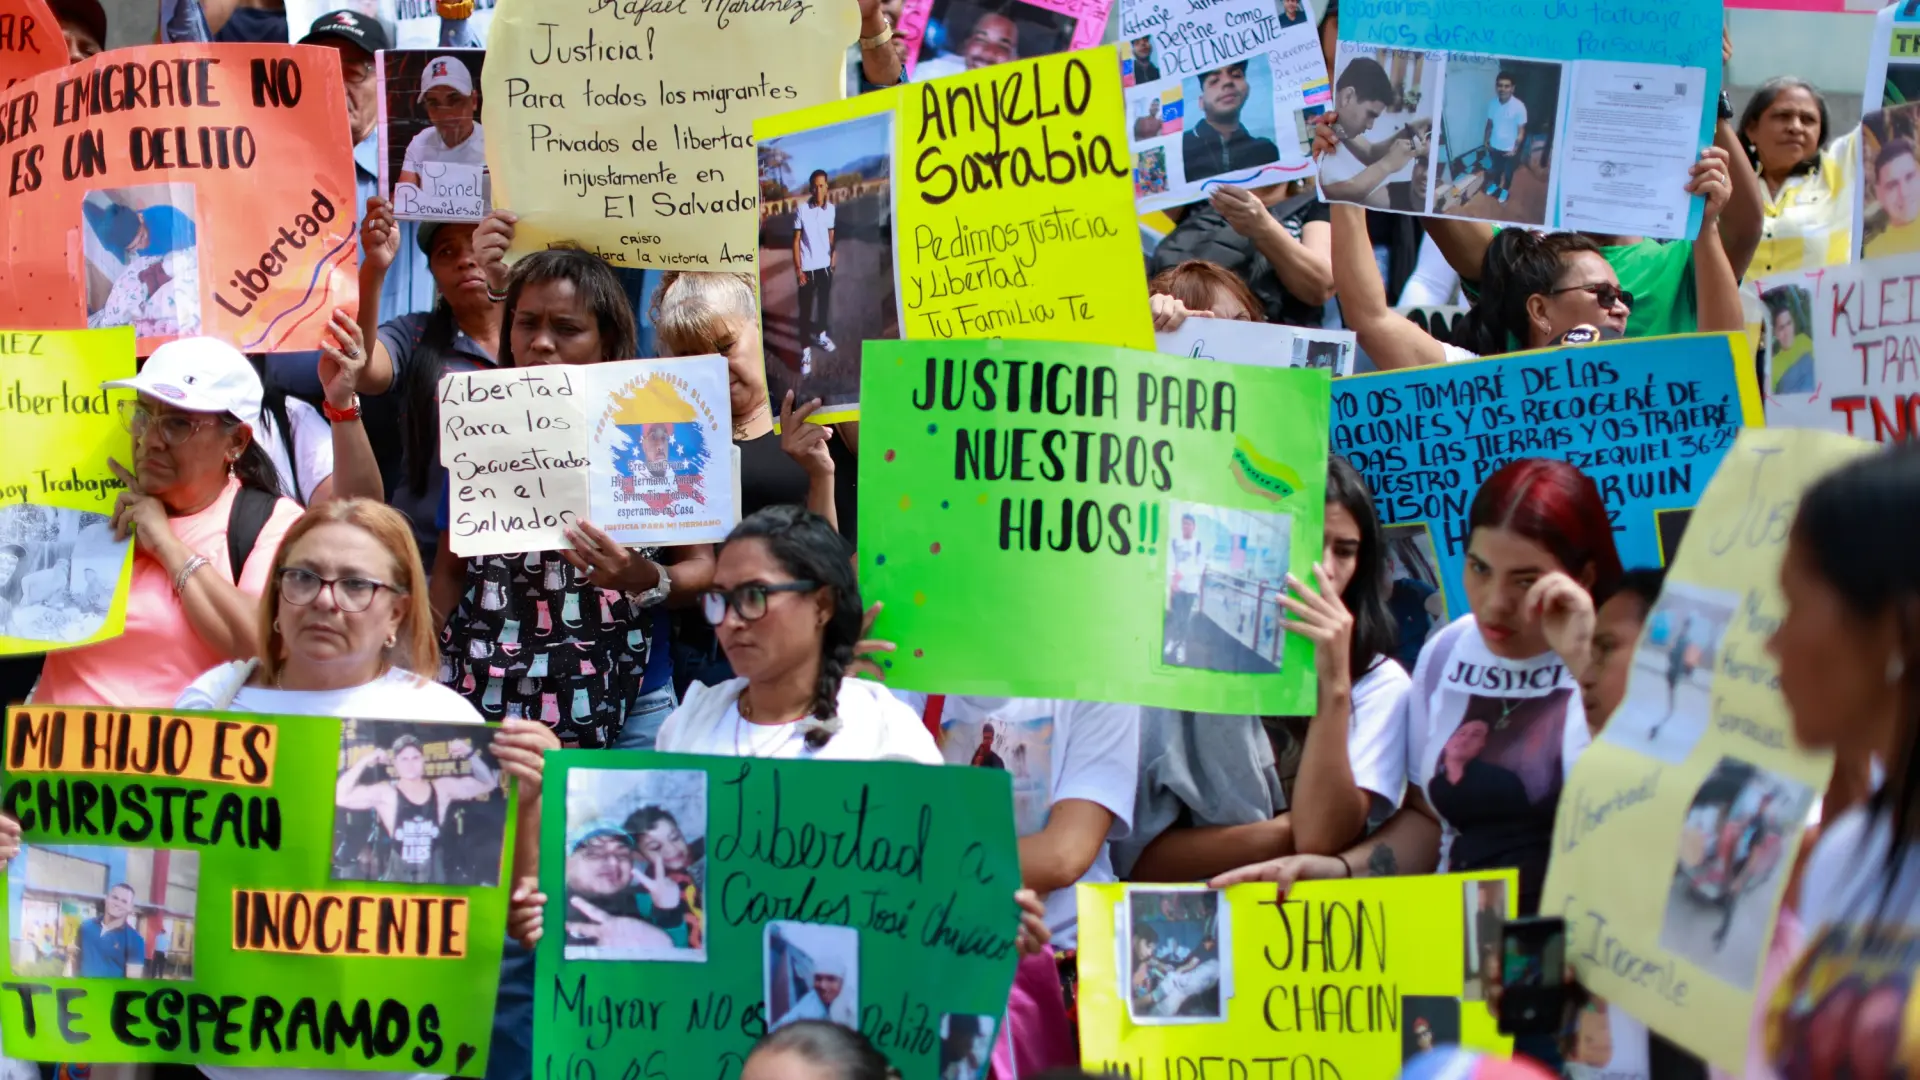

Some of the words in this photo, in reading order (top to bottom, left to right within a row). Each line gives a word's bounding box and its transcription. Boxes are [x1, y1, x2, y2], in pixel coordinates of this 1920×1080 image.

[529, 22, 655, 65] Justicia!
[54, 58, 221, 128] EMIGRATE
[250, 58, 302, 108] NO
[505, 77, 565, 109] Para
[583, 78, 646, 107] todos
[659, 79, 686, 106] los
[692, 72, 798, 114] migrantes
[8, 144, 43, 198] ES
[62, 128, 106, 182] UN
[129, 125, 256, 172] DELITO
[528, 122, 620, 153] Privados
[631, 125, 658, 153] de
[916, 124, 1128, 204] Sarabia
[424, 164, 482, 197] Yornel
[563, 162, 678, 198] injustamente
[697, 166, 725, 184] en
[604, 193, 635, 220] El
[636, 248, 653, 263] la
[914, 215, 1019, 264] Pedimos
[0, 379, 109, 415] ibertad
[441, 371, 574, 405] Libertad
[911, 356, 1118, 420] JUSTICIA
[1137, 371, 1237, 434] PARA
[1329, 413, 1453, 451] ACIONES
[1455, 407, 1475, 435] Y
[1482, 404, 1516, 430] OS
[1667, 381, 1704, 407] DE
[1331, 391, 1358, 420] YO
[1366, 387, 1403, 418] OS
[1522, 366, 1561, 396] DE
[1567, 358, 1620, 391] LAS
[445, 415, 510, 442] Para
[525, 409, 571, 433] los
[1418, 441, 1467, 467] LAS
[1464, 427, 1573, 461] TIERRAS
[1579, 420, 1597, 444] Y
[1602, 418, 1639, 442] OS
[954, 427, 1175, 492] NUESTROS
[1362, 469, 1461, 496] UESTRO
[1565, 438, 1673, 470] EZEQUIEL
[458, 484, 496, 502] en
[514, 477, 547, 499] el
[674, 504, 695, 515] Casa
[999, 496, 1160, 556] HIJOS!!
[1447, 660, 1564, 691] JUSTICI
[10, 710, 67, 770] MI
[80, 712, 194, 775] HIJO
[210, 721, 271, 785] ES
[3, 778, 283, 852] CHRISTEAN
[715, 762, 931, 883] Libertad
[960, 841, 996, 886] a
[233, 889, 467, 958] INOCENTE
[721, 872, 850, 928] Carlos
[1257, 898, 1387, 974] JHON
[1, 980, 92, 1044] TE
[552, 973, 666, 1051] Migrar
[1262, 982, 1398, 1034] CHACIN
